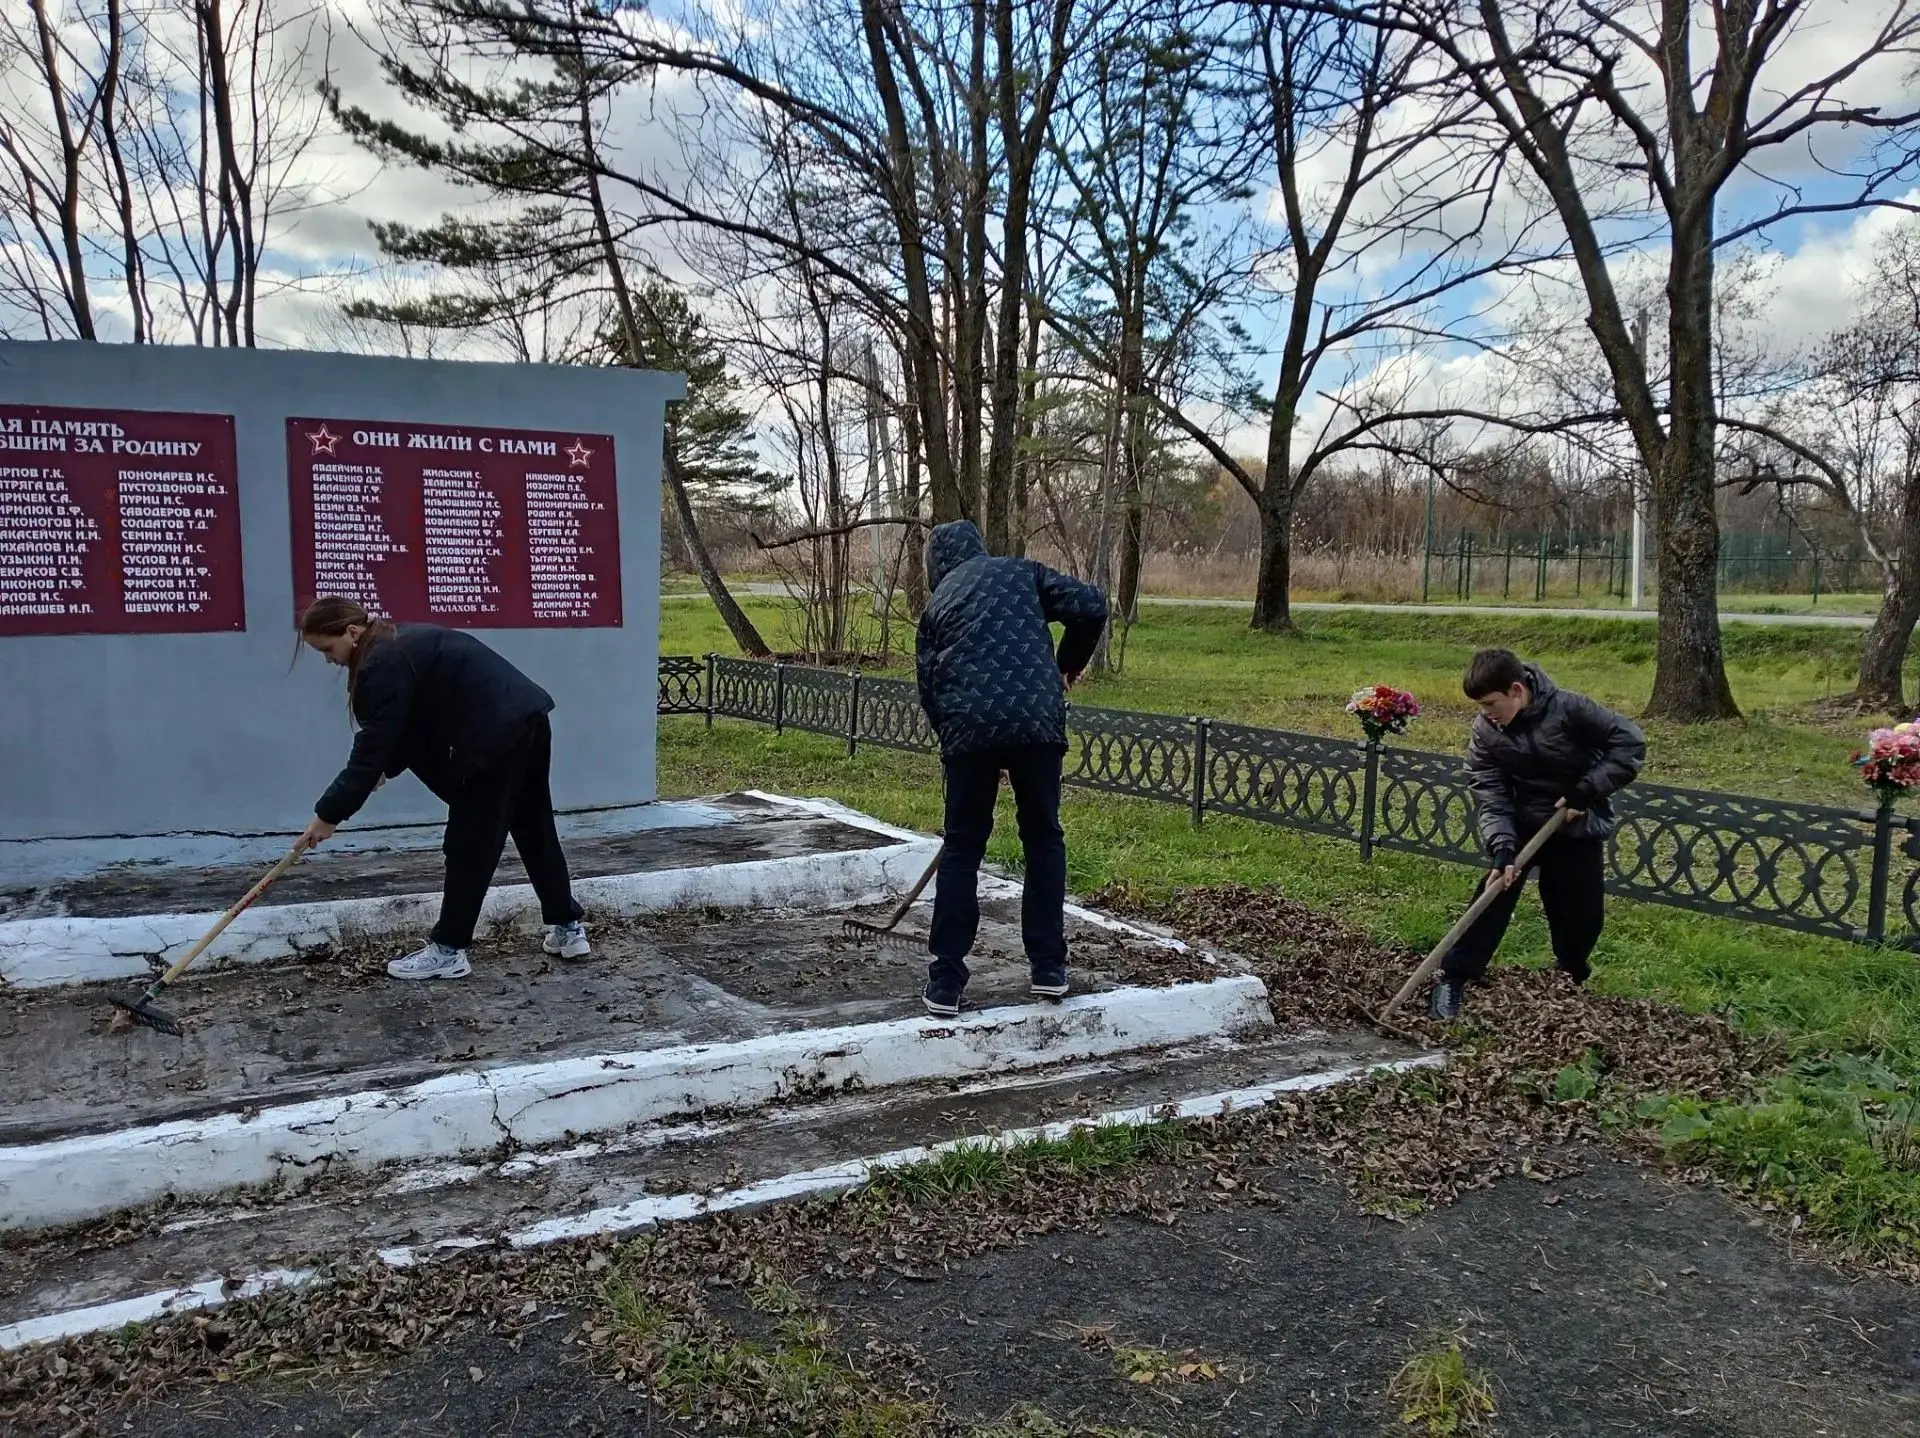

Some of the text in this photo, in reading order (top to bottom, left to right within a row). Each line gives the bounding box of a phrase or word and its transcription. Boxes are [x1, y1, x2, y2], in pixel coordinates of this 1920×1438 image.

[31, 420, 124, 437] ПАМЯТЬ
[74, 438, 104, 453] ЗА
[113, 439, 202, 456] РОДИНУ
[352, 430, 556, 456] ОНИ ЖИЛИ С НАМИ
[43, 469, 64, 478] Г.К.
[119, 471, 217, 482] ПОНОМАРЕВ И.С.
[46, 482, 68, 491] В.А.
[120, 483, 228, 494] ПУСТОЗВОНОВ А.З.
[50, 494, 72, 503] С.А.
[164, 496, 184, 504] И.С.
[57, 506, 84, 515] В.Ф.
[120, 507, 216, 517] САВОДЕРОВ А.И.
[76, 518, 98, 528] Н.Е.
[121, 519, 208, 529] СОЛДАТОВ Т.Д.
[76, 531, 101, 540] И.М.
[122, 531, 186, 540] СЕМИН В.Т.
[66, 543, 89, 552] Н.А.
[122, 543, 205, 553] СТАРУХИН И.С.
[58, 556, 82, 564] П.И.
[122, 555, 193, 565] СУСЛОВ И.А.
[61, 568, 83, 576] С.В.
[123, 568, 211, 576] ФЕДОТОВ И.Ф.
[59, 580, 86, 589] П.Ф.
[124, 580, 199, 588] ФИРСОВ И.Т.
[0, 592, 63, 602] РЛОВ И.С.
[124, 592, 210, 600] ХАЛЮКОВ П.Н.
[0, 604, 93, 615] АНАКШЕВ И.П.
[125, 604, 202, 612] ШЕВЧУК Н.Ф.
